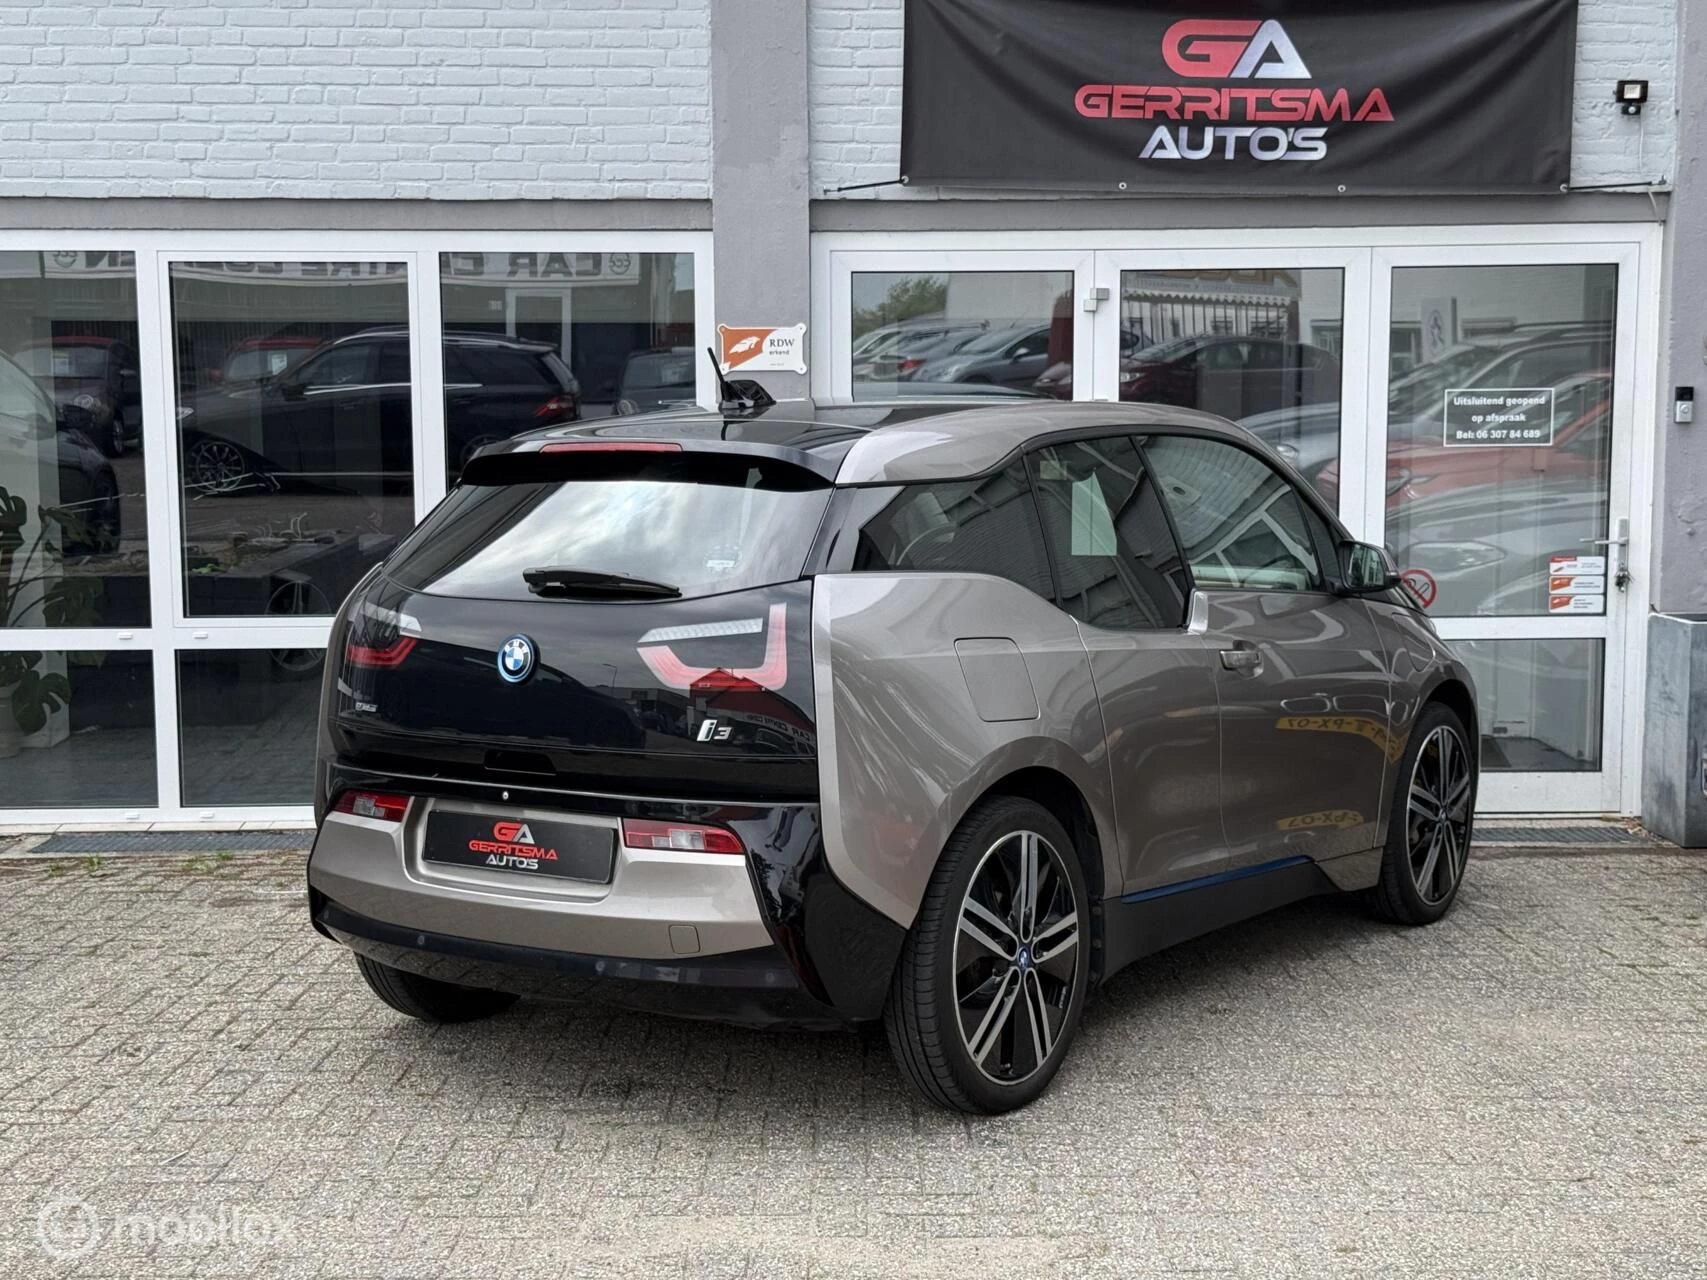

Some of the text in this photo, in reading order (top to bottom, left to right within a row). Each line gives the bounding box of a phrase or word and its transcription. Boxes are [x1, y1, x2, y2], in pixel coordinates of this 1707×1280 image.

[1161, 18, 1312, 79] GA
[1074, 84, 1395, 122] GERRITSMA
[1138, 124, 1328, 161] AUTO'S
[769, 338, 794, 348] RDW
[1453, 396, 1546, 407] Uitsluitend geopend
[1471, 413, 1527, 424] op afspraak
[1476, 430, 1488, 439] 06
[1490, 429, 1507, 439] 307
[1509, 429, 1521, 438] 84
[1523, 429, 1541, 438] 689
[697, 719, 732, 741] i3
[493, 822, 535, 844] GA
[468, 840, 559, 861] GERRITSMA
